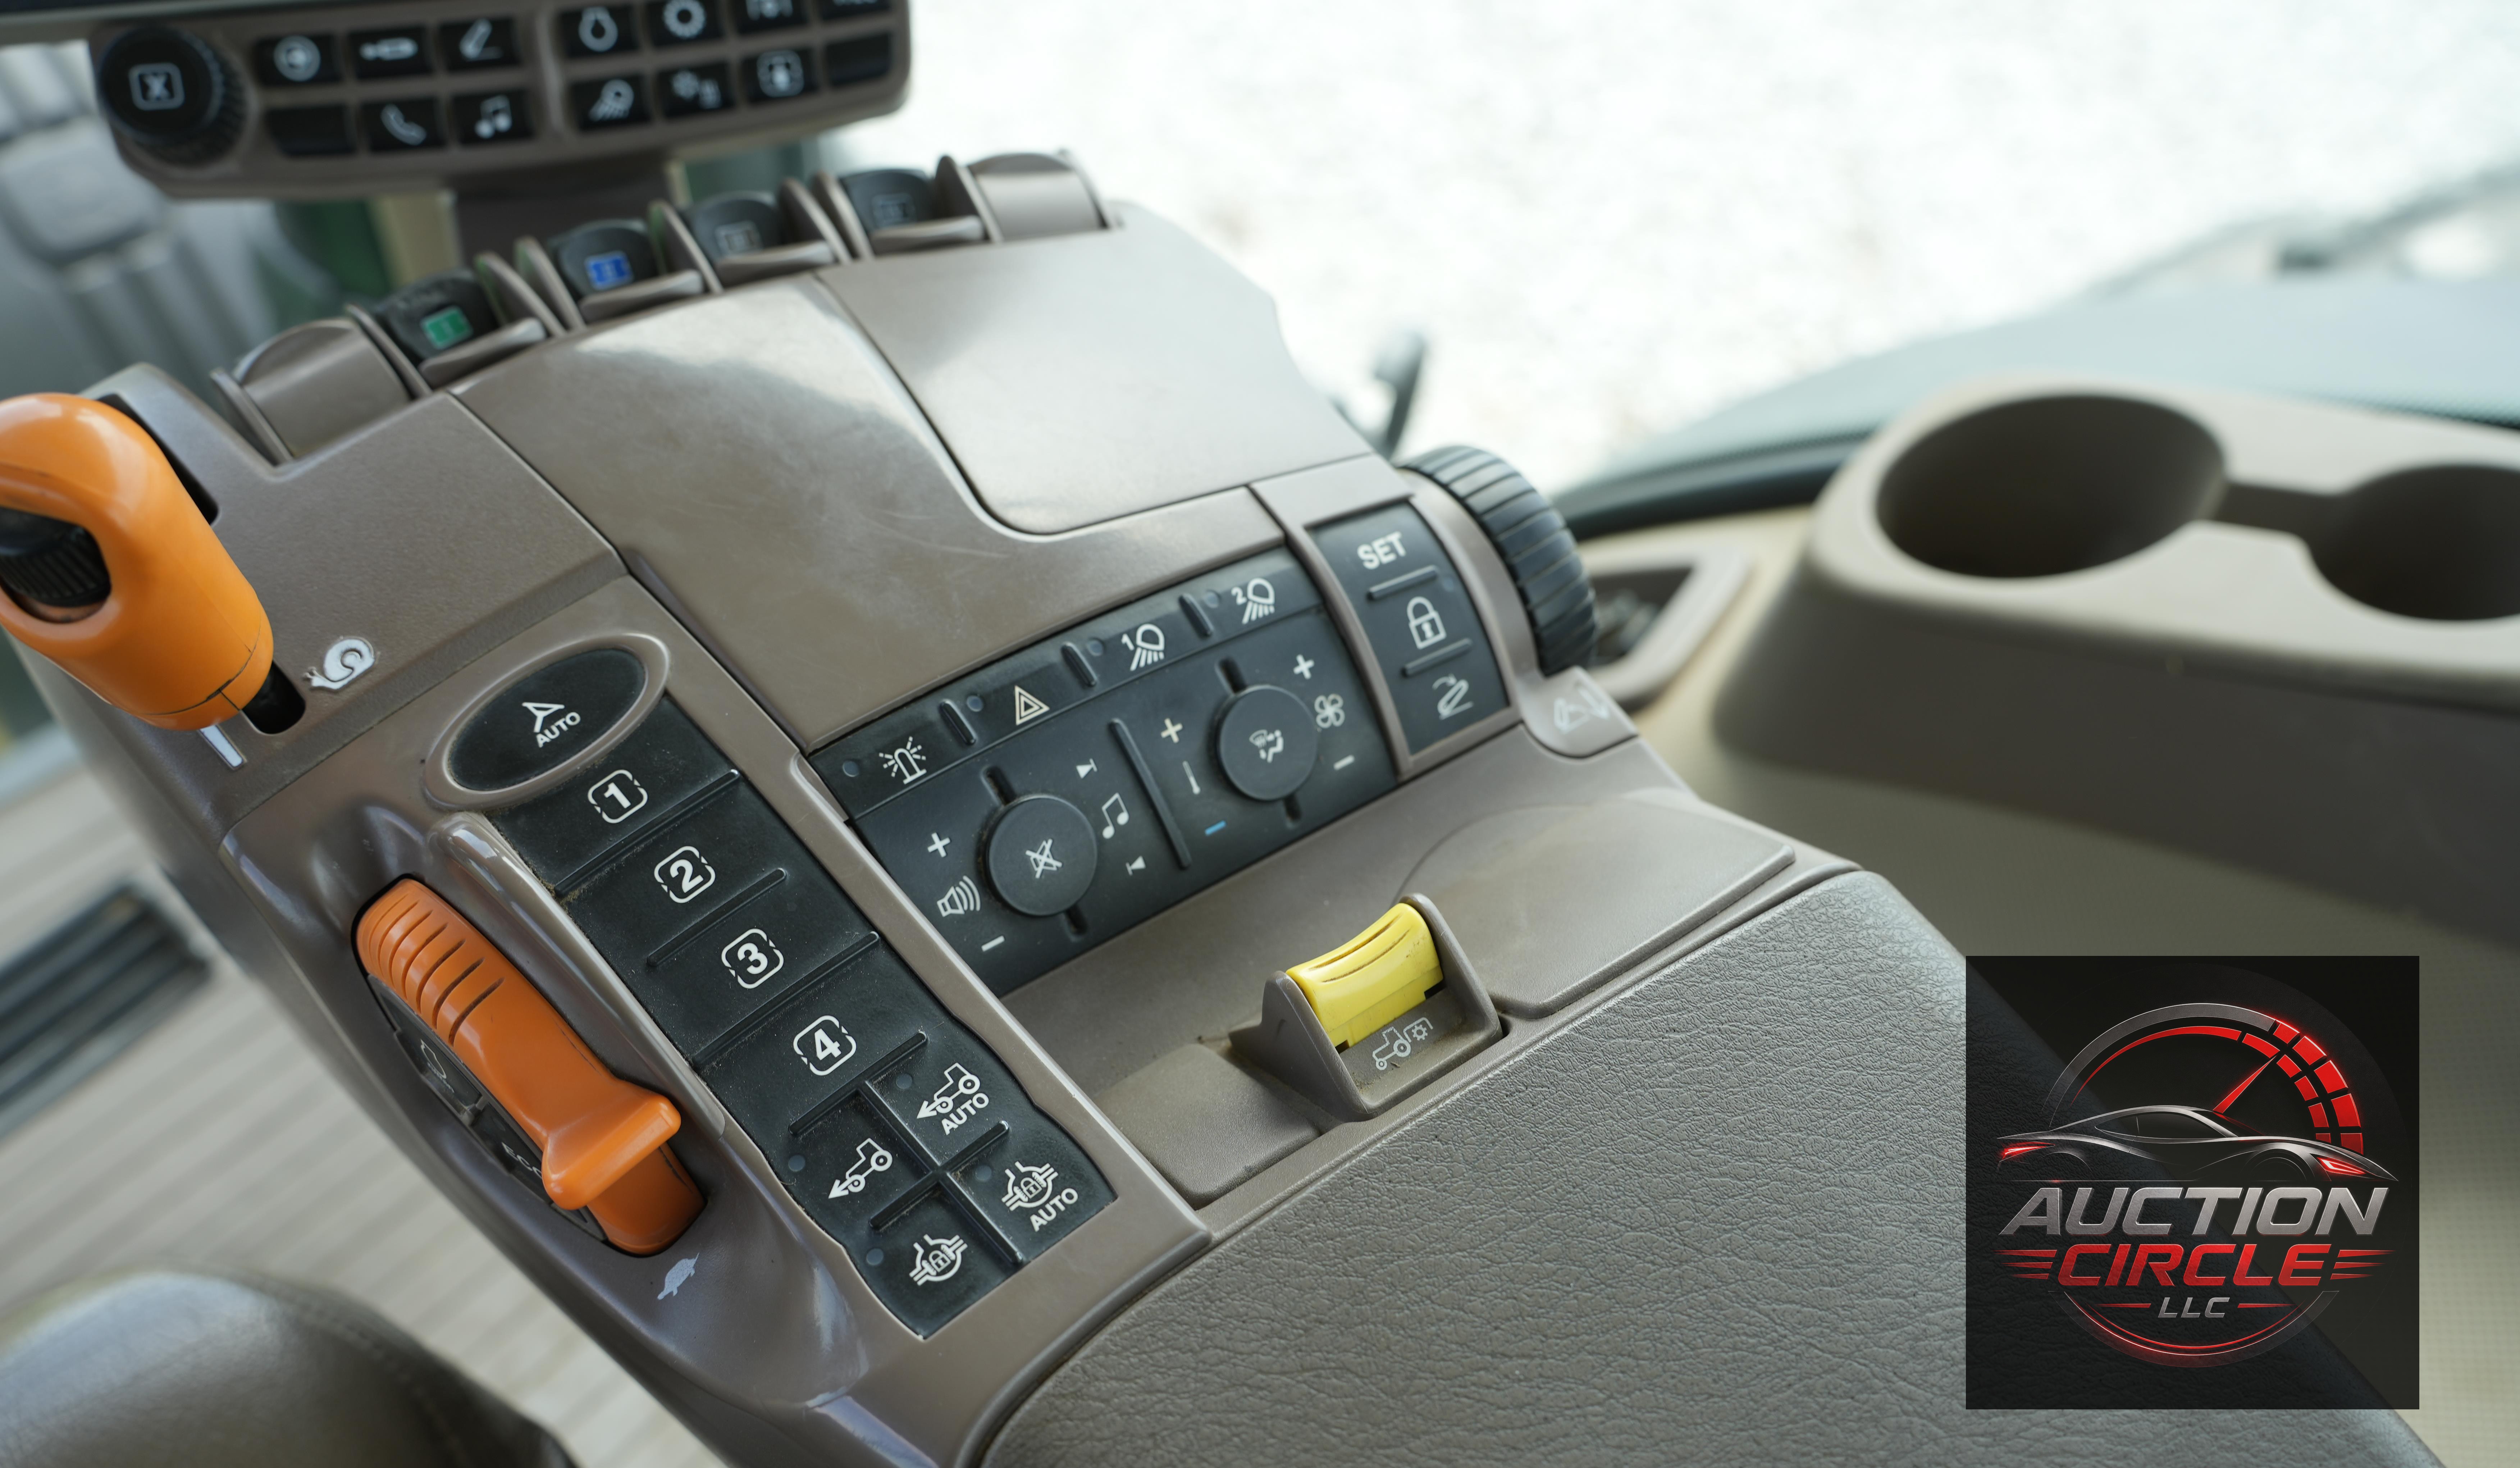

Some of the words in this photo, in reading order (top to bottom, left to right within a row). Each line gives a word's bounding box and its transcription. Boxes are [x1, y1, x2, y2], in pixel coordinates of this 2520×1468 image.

[1357, 531, 1406, 569] SET
[1231, 587, 1247, 605] 2
[1121, 634, 1135, 651] 1
[536, 712, 581, 748] AUTO
[604, 783, 631, 809] 1
[670, 859, 704, 893] 2
[737, 943, 768, 974] 3
[814, 1028, 841, 1061] 4
[941, 1092, 989, 1135] AUTO
[1030, 1187, 1078, 1232] AUTO
